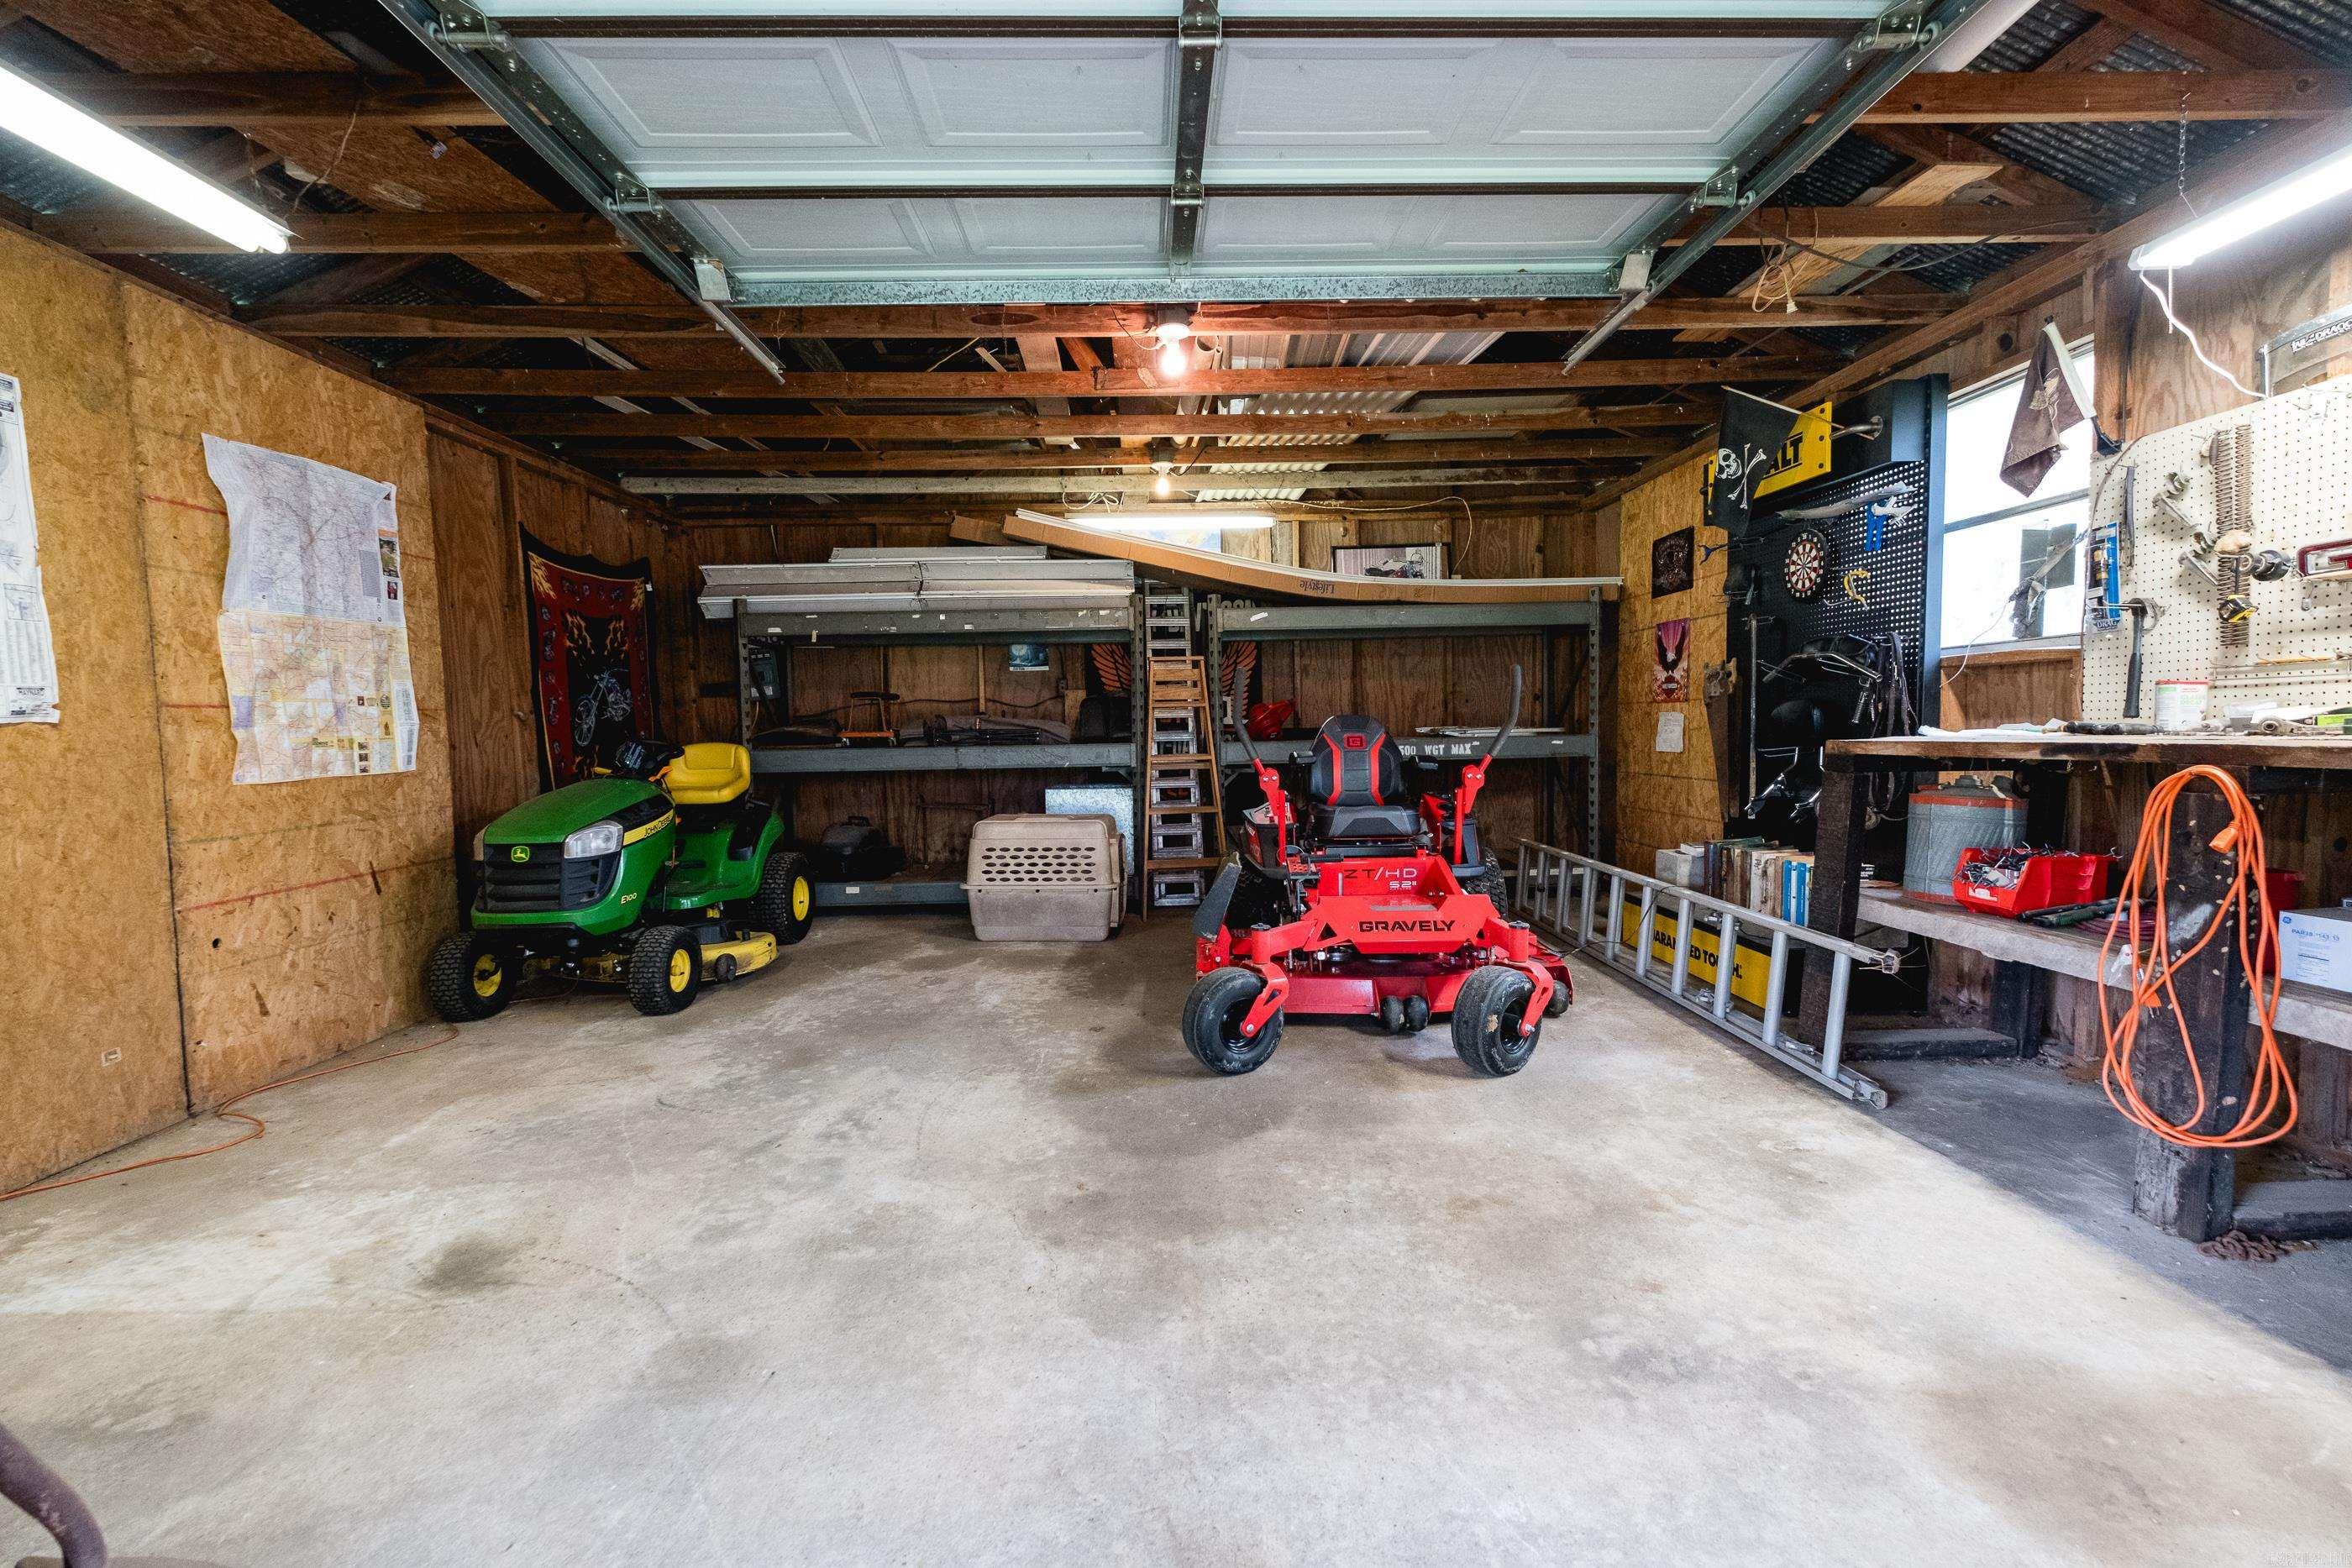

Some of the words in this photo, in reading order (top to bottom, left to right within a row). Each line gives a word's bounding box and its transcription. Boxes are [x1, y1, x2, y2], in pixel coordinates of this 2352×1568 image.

[1765, 437, 1803, 474] ALT
[1299, 579, 1336, 594] Lifestyle
[1425, 744, 1445, 755] WGT
[1451, 743, 1472, 754] MAX
[644, 825, 659, 836] JOHN
[621, 892, 638, 905] E100
[1358, 920, 1456, 933] GRAVELY
